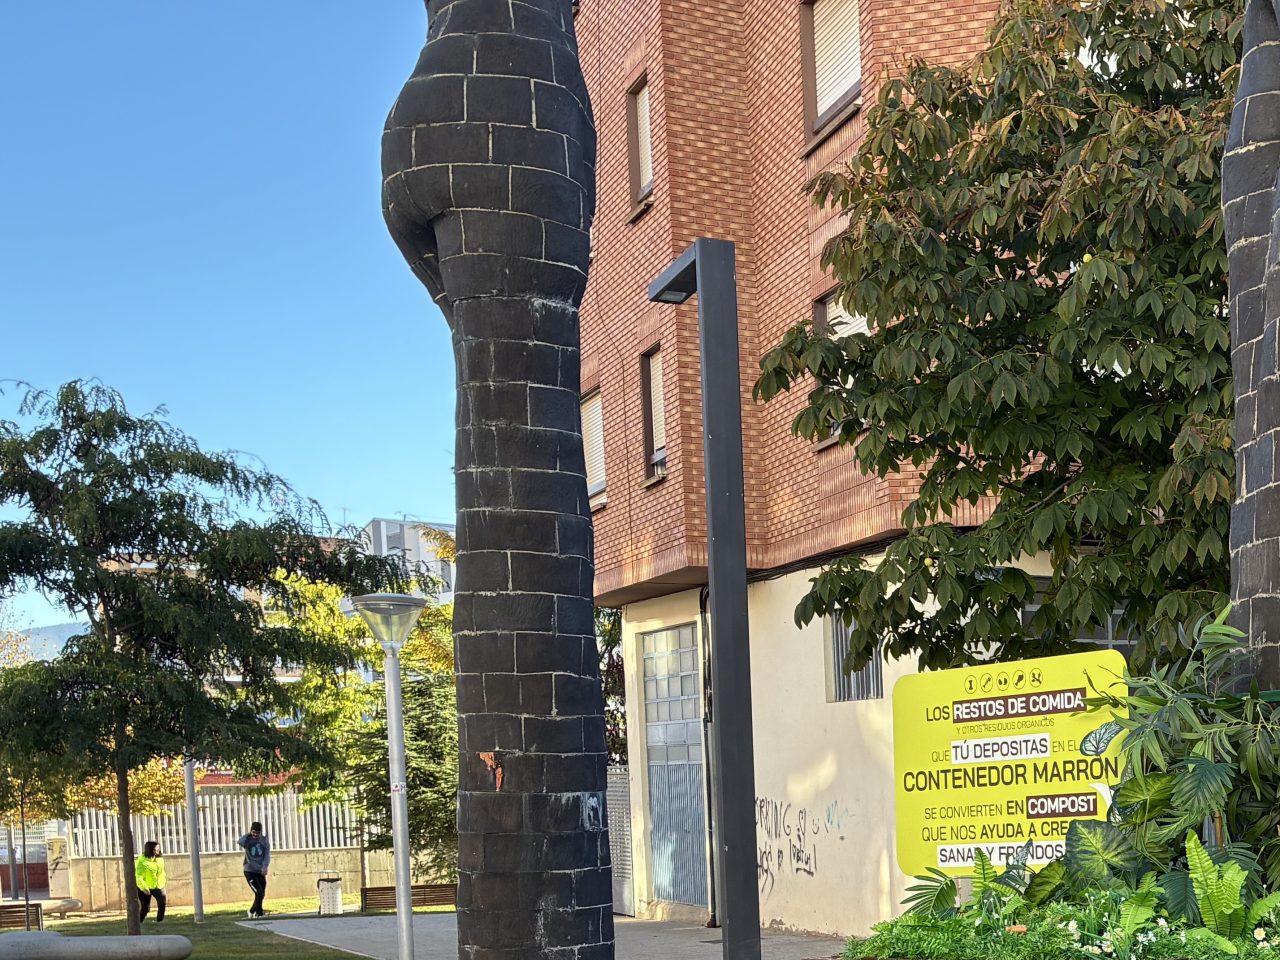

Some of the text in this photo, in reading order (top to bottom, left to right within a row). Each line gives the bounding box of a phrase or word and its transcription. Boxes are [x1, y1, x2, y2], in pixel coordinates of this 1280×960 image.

[926, 691, 1084, 722] LOS RESTOS DE COMIDA
[962, 724, 982, 734] OTROS
[984, 722, 1016, 732] RESIDUOS
[932, 738, 1080, 762] QUE TÚ DEPOSITAS EN EL
[904, 764, 1027, 792] CONTENEDOR
[924, 795, 1096, 820] SE CONVIERTEN EN COMPOST
[922, 820, 1068, 842] QUE NOS AYUDA A CRE
[940, 848, 979, 862] SANA
[986, 846, 994, 860] Y
